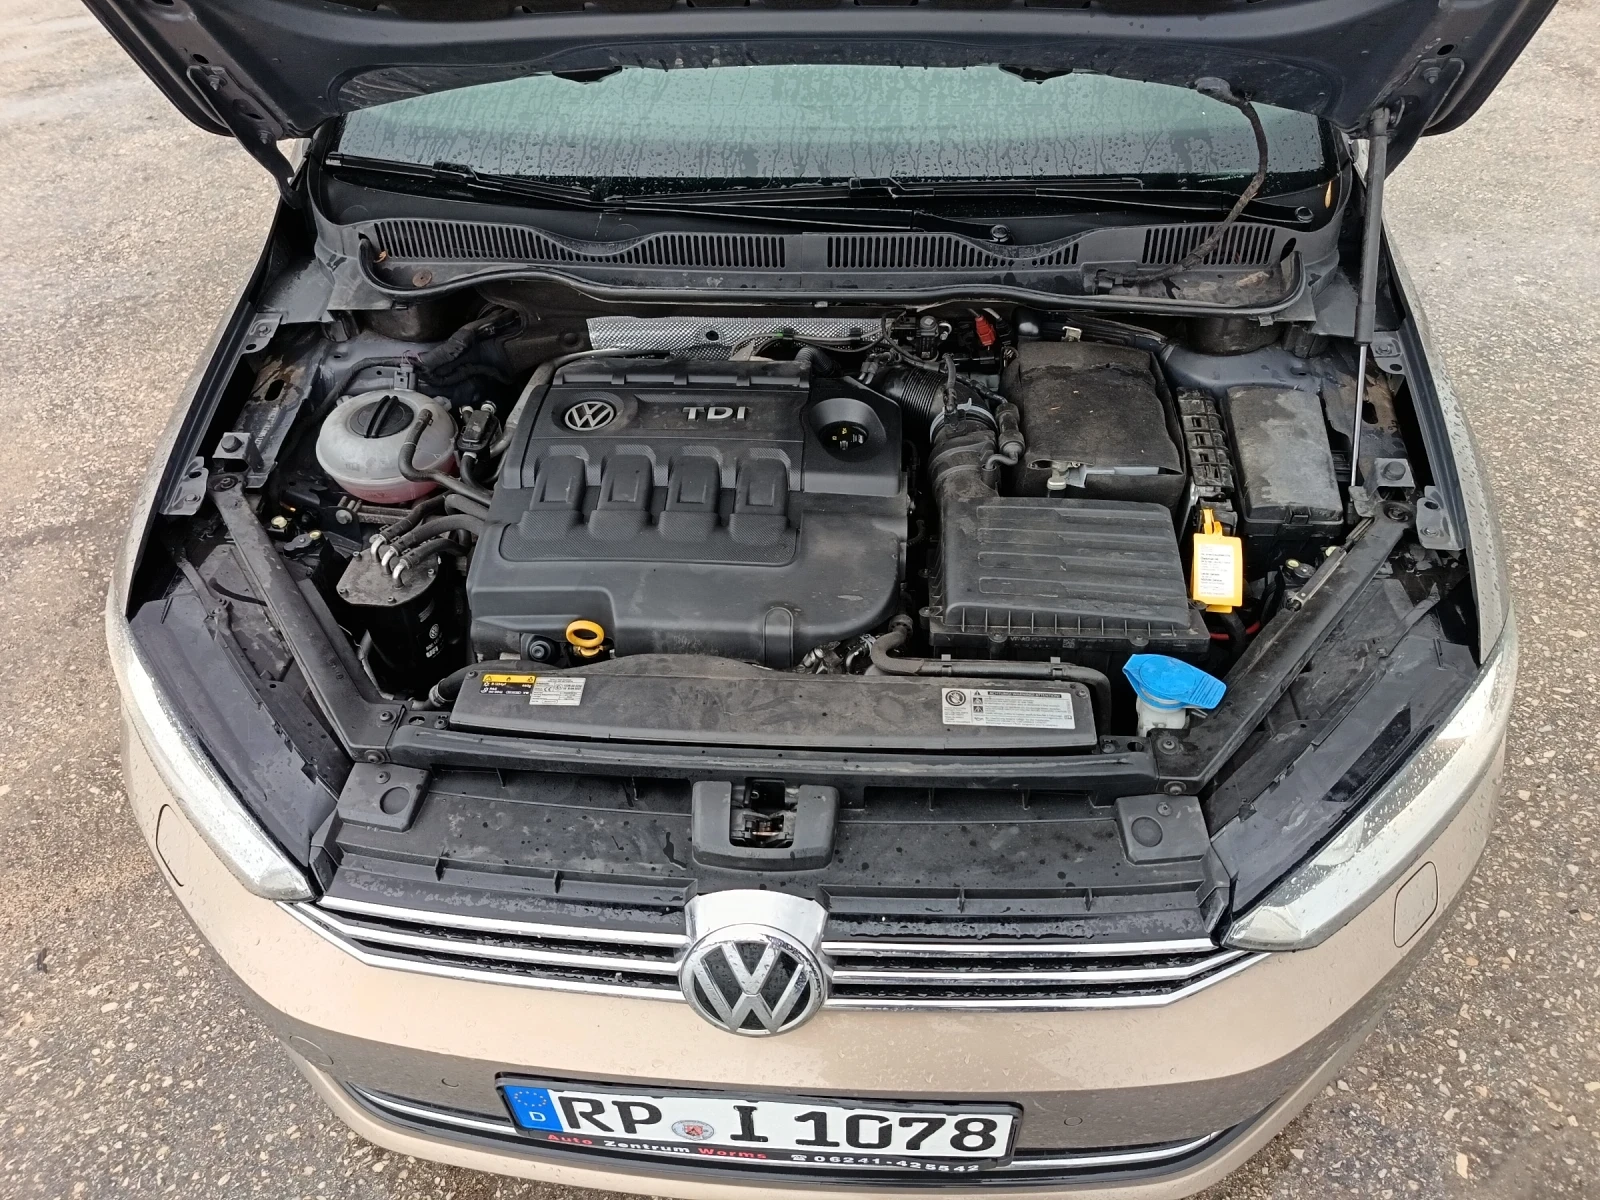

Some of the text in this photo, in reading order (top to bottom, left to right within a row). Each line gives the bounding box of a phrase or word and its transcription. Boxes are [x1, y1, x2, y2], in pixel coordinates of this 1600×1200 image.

[682, 406, 749, 421] TDI
[683, 924, 823, 1036] VW
[529, 1111, 547, 1123] D
[558, 1096, 663, 1134] RP
[729, 1105, 769, 1142] I
[794, 1111, 998, 1152] 1078
[547, 1133, 593, 1145] Auto
[603, 1140, 691, 1153] Zentrum
[698, 1147, 767, 1159] Worms
